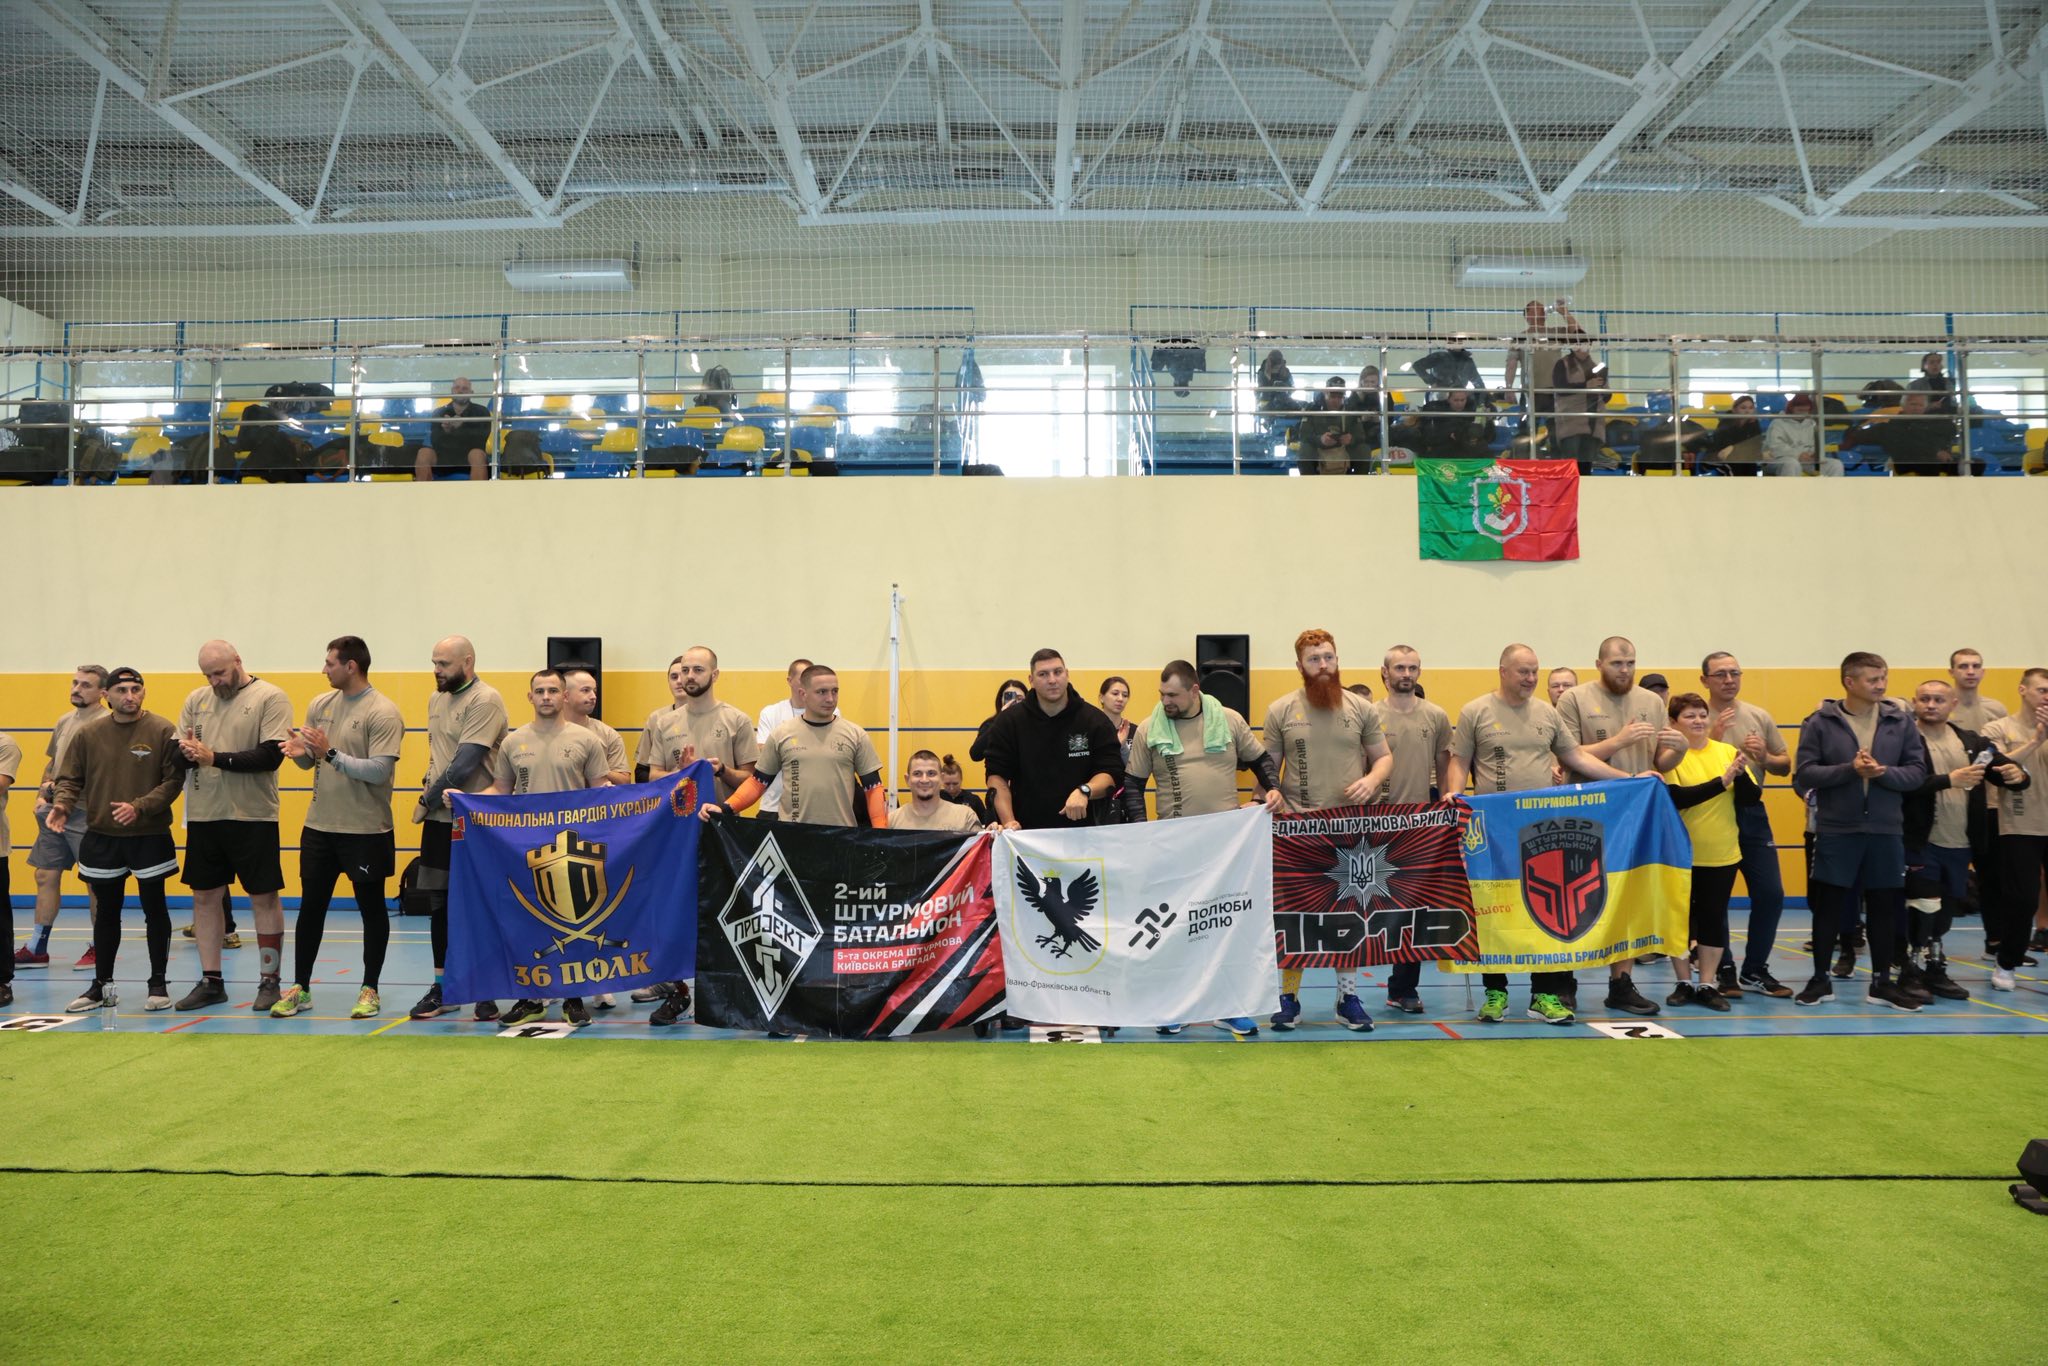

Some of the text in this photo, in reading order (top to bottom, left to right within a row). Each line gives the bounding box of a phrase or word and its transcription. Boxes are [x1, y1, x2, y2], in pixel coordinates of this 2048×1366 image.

[1295, 738, 1309, 787] ВЕТЕРАНІВ
[1494, 745, 1506, 792] ВЕТЕРАНІВ
[791, 760, 800, 809] ВЕТЕРАНІВ
[469, 796, 662, 828] НАЦІОНАЛЬНА ГВАРДІЯ УКРАЇНИ
[1515, 792, 1607, 810] 1 ШТУРМОВА РОТА
[1331, 815, 1409, 835] ШТУРМОВА
[1532, 819, 1593, 834] ТАВР
[834, 882, 887, 900] 2-ий
[834, 882, 975, 921] ШТУРМОВИЙ
[1188, 899, 1252, 921] ПОЛЮБИ
[833, 910, 962, 943] БАТАЛЬЙОН
[1188, 916, 1233, 936] ДОЛЮ
[862, 950, 904, 960] ОКРЕМА
[906, 936, 963, 957] ШТУРМОВА
[1514, 952, 1573, 965] ШТУРМОВА
[1614, 940, 1628, 953] НПУ
[513, 951, 652, 987] 36 ПОЛК
[837, 952, 936, 971] КИЇВСЬКА БРИГАДА
[1079, 984, 1111, 996] область
